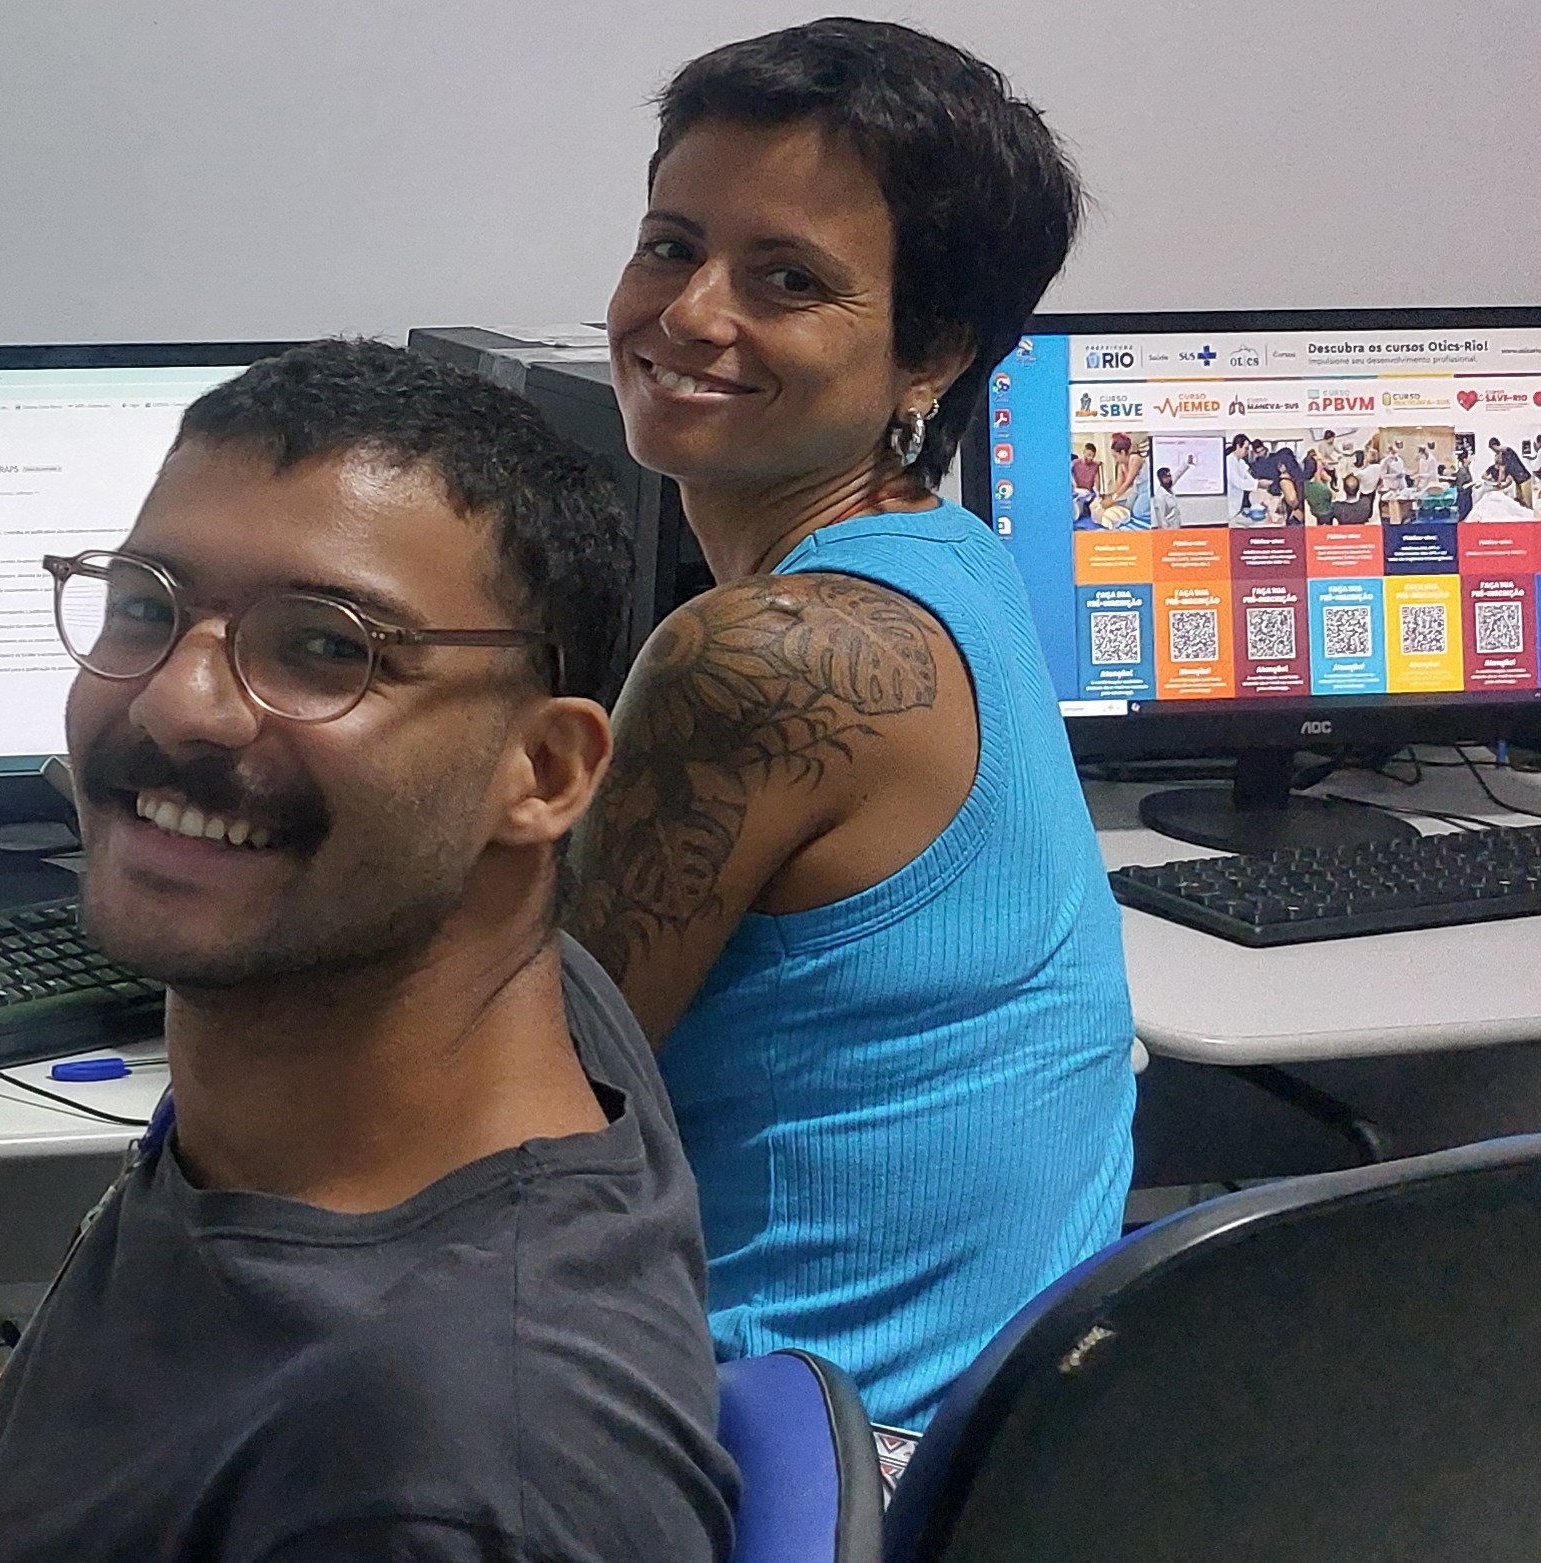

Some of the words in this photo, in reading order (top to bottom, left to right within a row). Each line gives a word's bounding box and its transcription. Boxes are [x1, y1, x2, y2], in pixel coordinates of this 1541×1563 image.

[1308, 341, 1364, 353] Descubra
[1368, 344, 1382, 352] os
[1385, 343, 1424, 353] cursos
[1428, 340, 1488, 352] Otics-Rio!
[1102, 352, 1134, 368] RIO
[1179, 352, 1196, 360] SUS
[1322, 389, 1350, 397] CURSO
[1100, 403, 1143, 417] SBVE
[1179, 400, 1220, 412] IEMED
[1322, 396, 1374, 412] PBVM
[0, 465, 19, 473] RAPS
[1301, 721, 1332, 734] AOC
